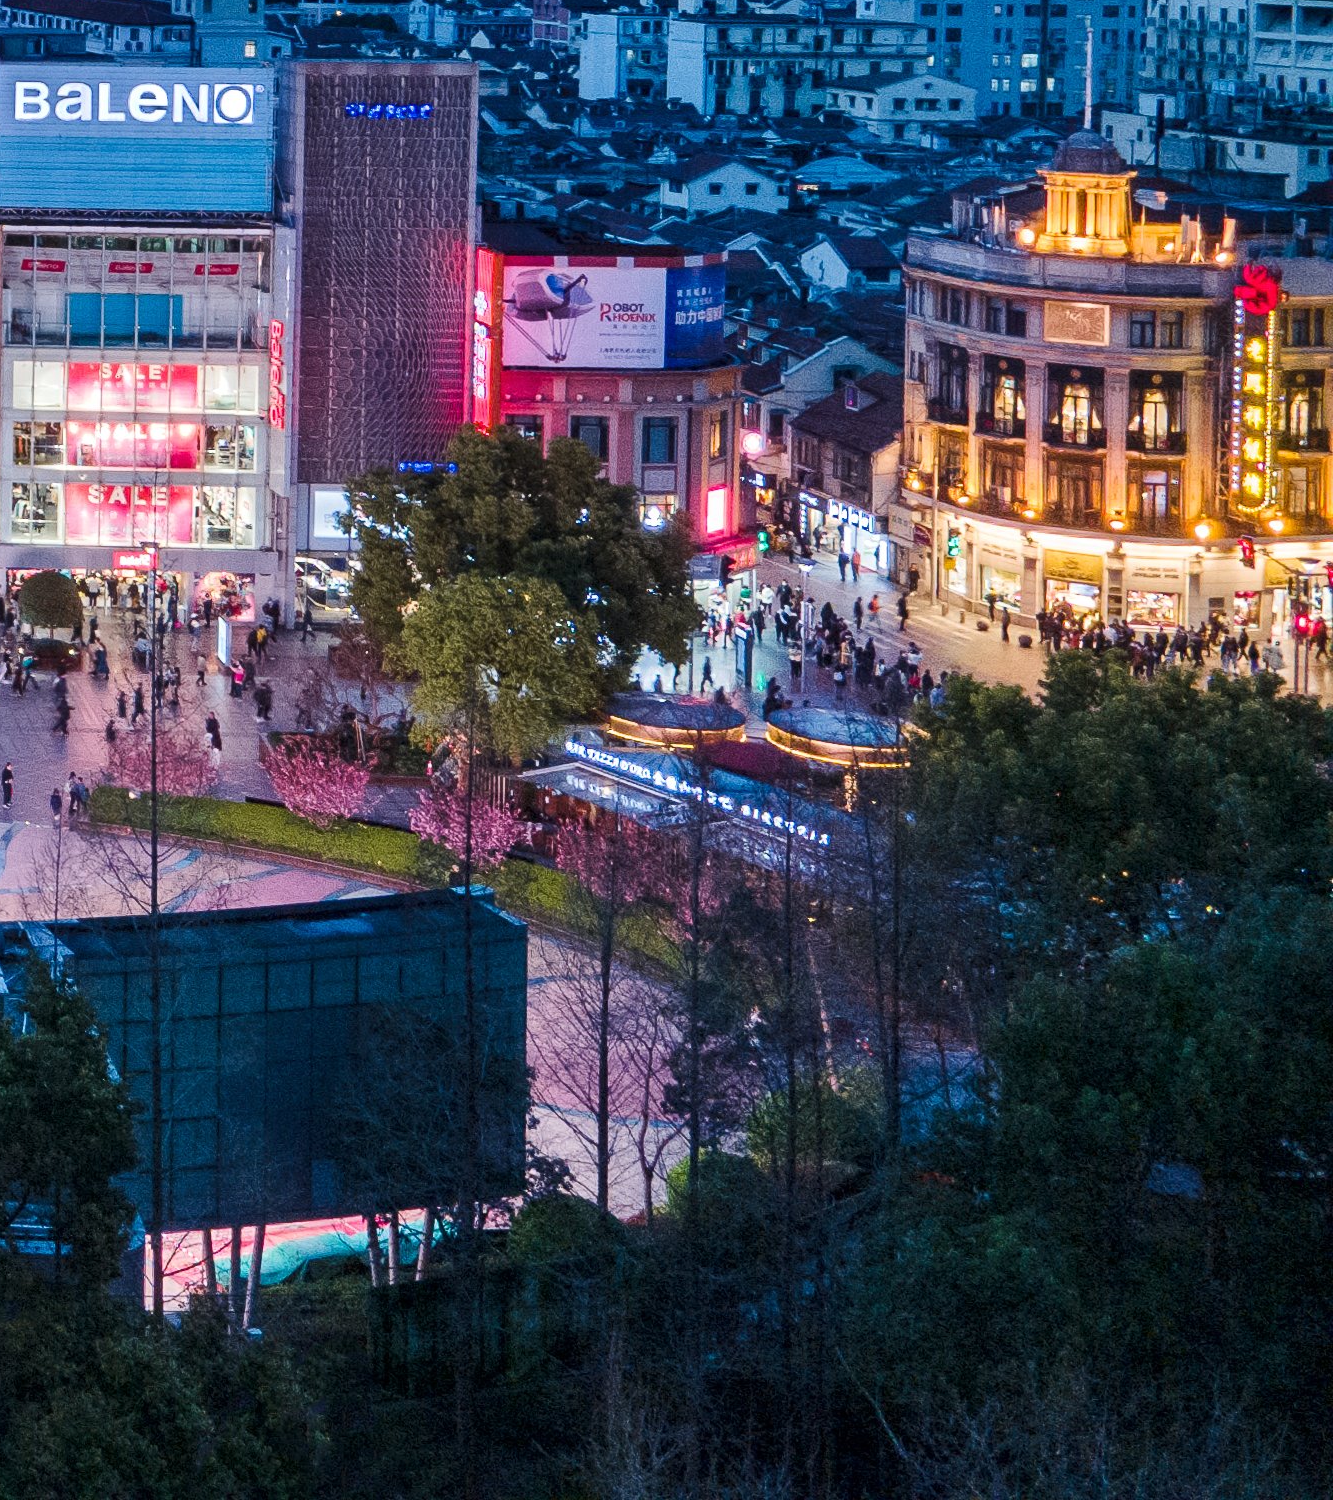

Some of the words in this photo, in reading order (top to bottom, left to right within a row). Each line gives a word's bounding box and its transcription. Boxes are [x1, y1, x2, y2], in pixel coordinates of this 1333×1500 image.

[100, 363, 162, 381] SALE
[95, 422, 169, 441] SALE
[88, 484, 169, 506] SALE
[587, 748, 620, 768] TAZZA
